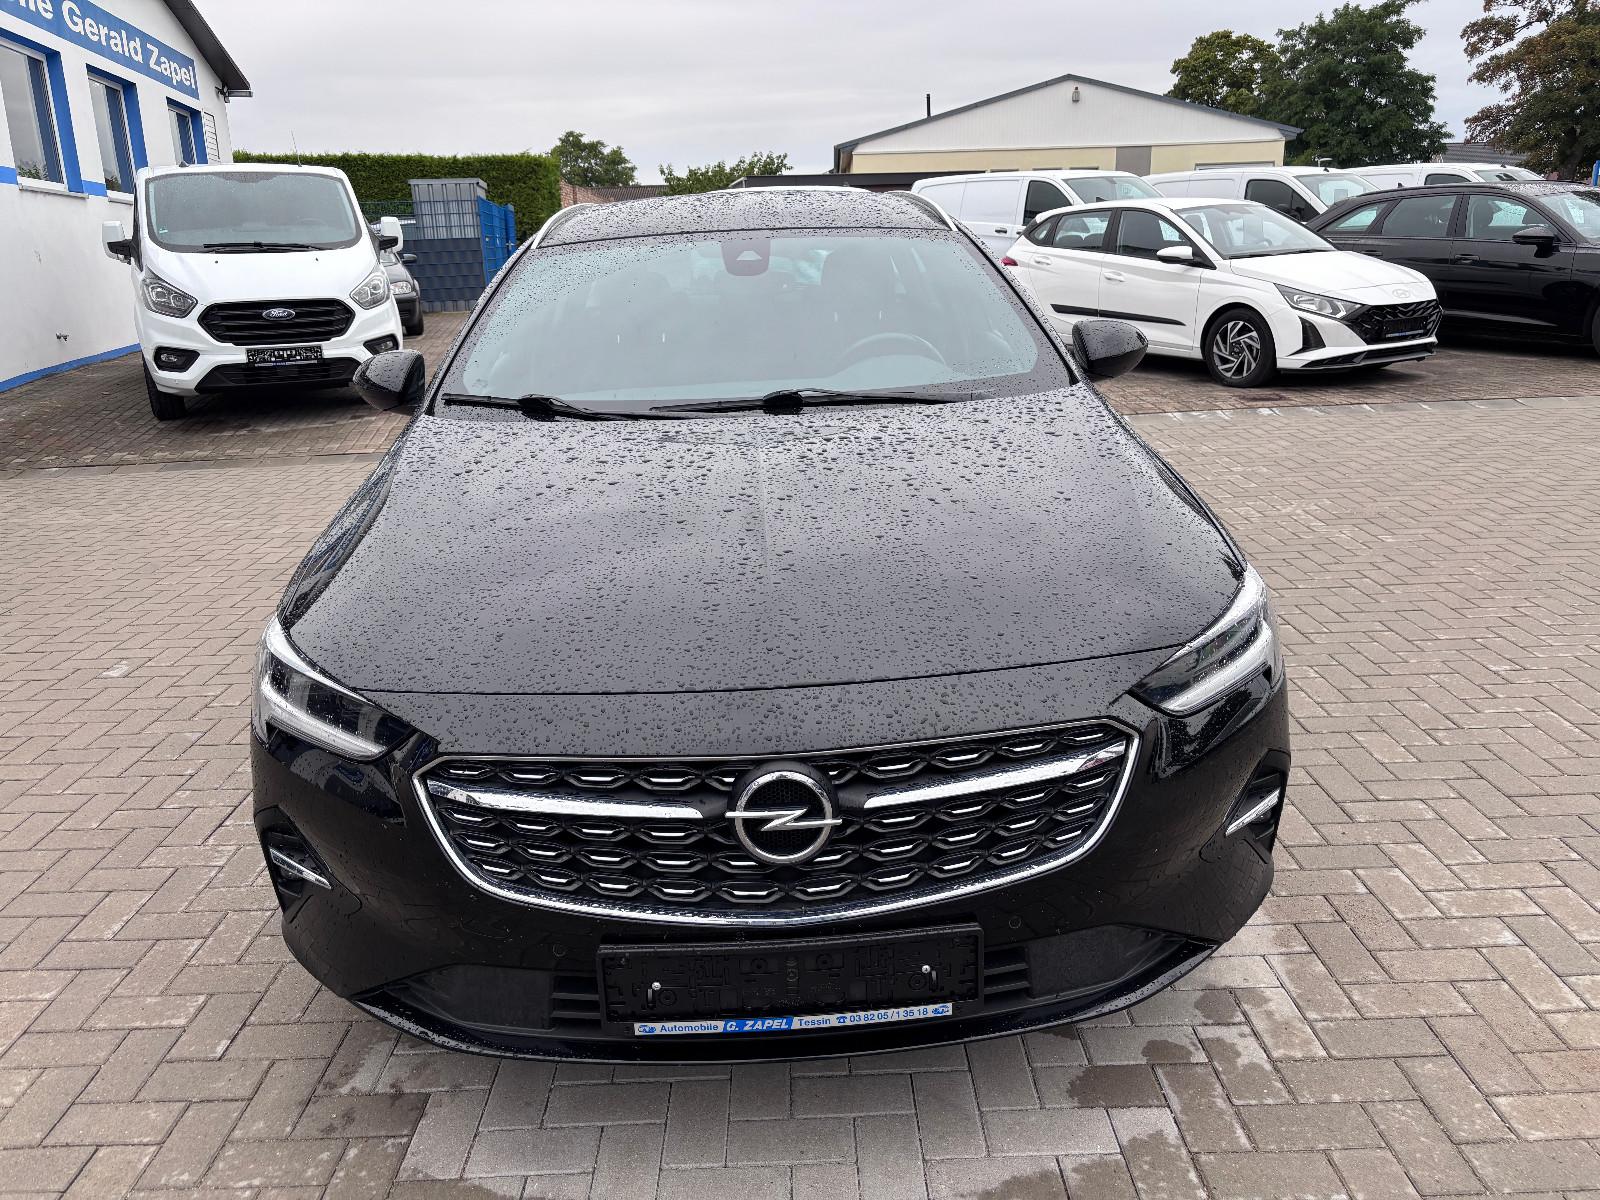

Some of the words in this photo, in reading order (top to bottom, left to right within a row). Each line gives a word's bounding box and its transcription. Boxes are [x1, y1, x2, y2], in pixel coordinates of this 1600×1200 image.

[61, 0, 143, 64] Gerald
[146, 43, 196, 90] Zapel
[659, 1023, 719, 1033] Automobile
[726, 1021, 739, 1031] G.
[743, 1019, 789, 1031] ZAPEL
[797, 1017, 831, 1027] Tessin
